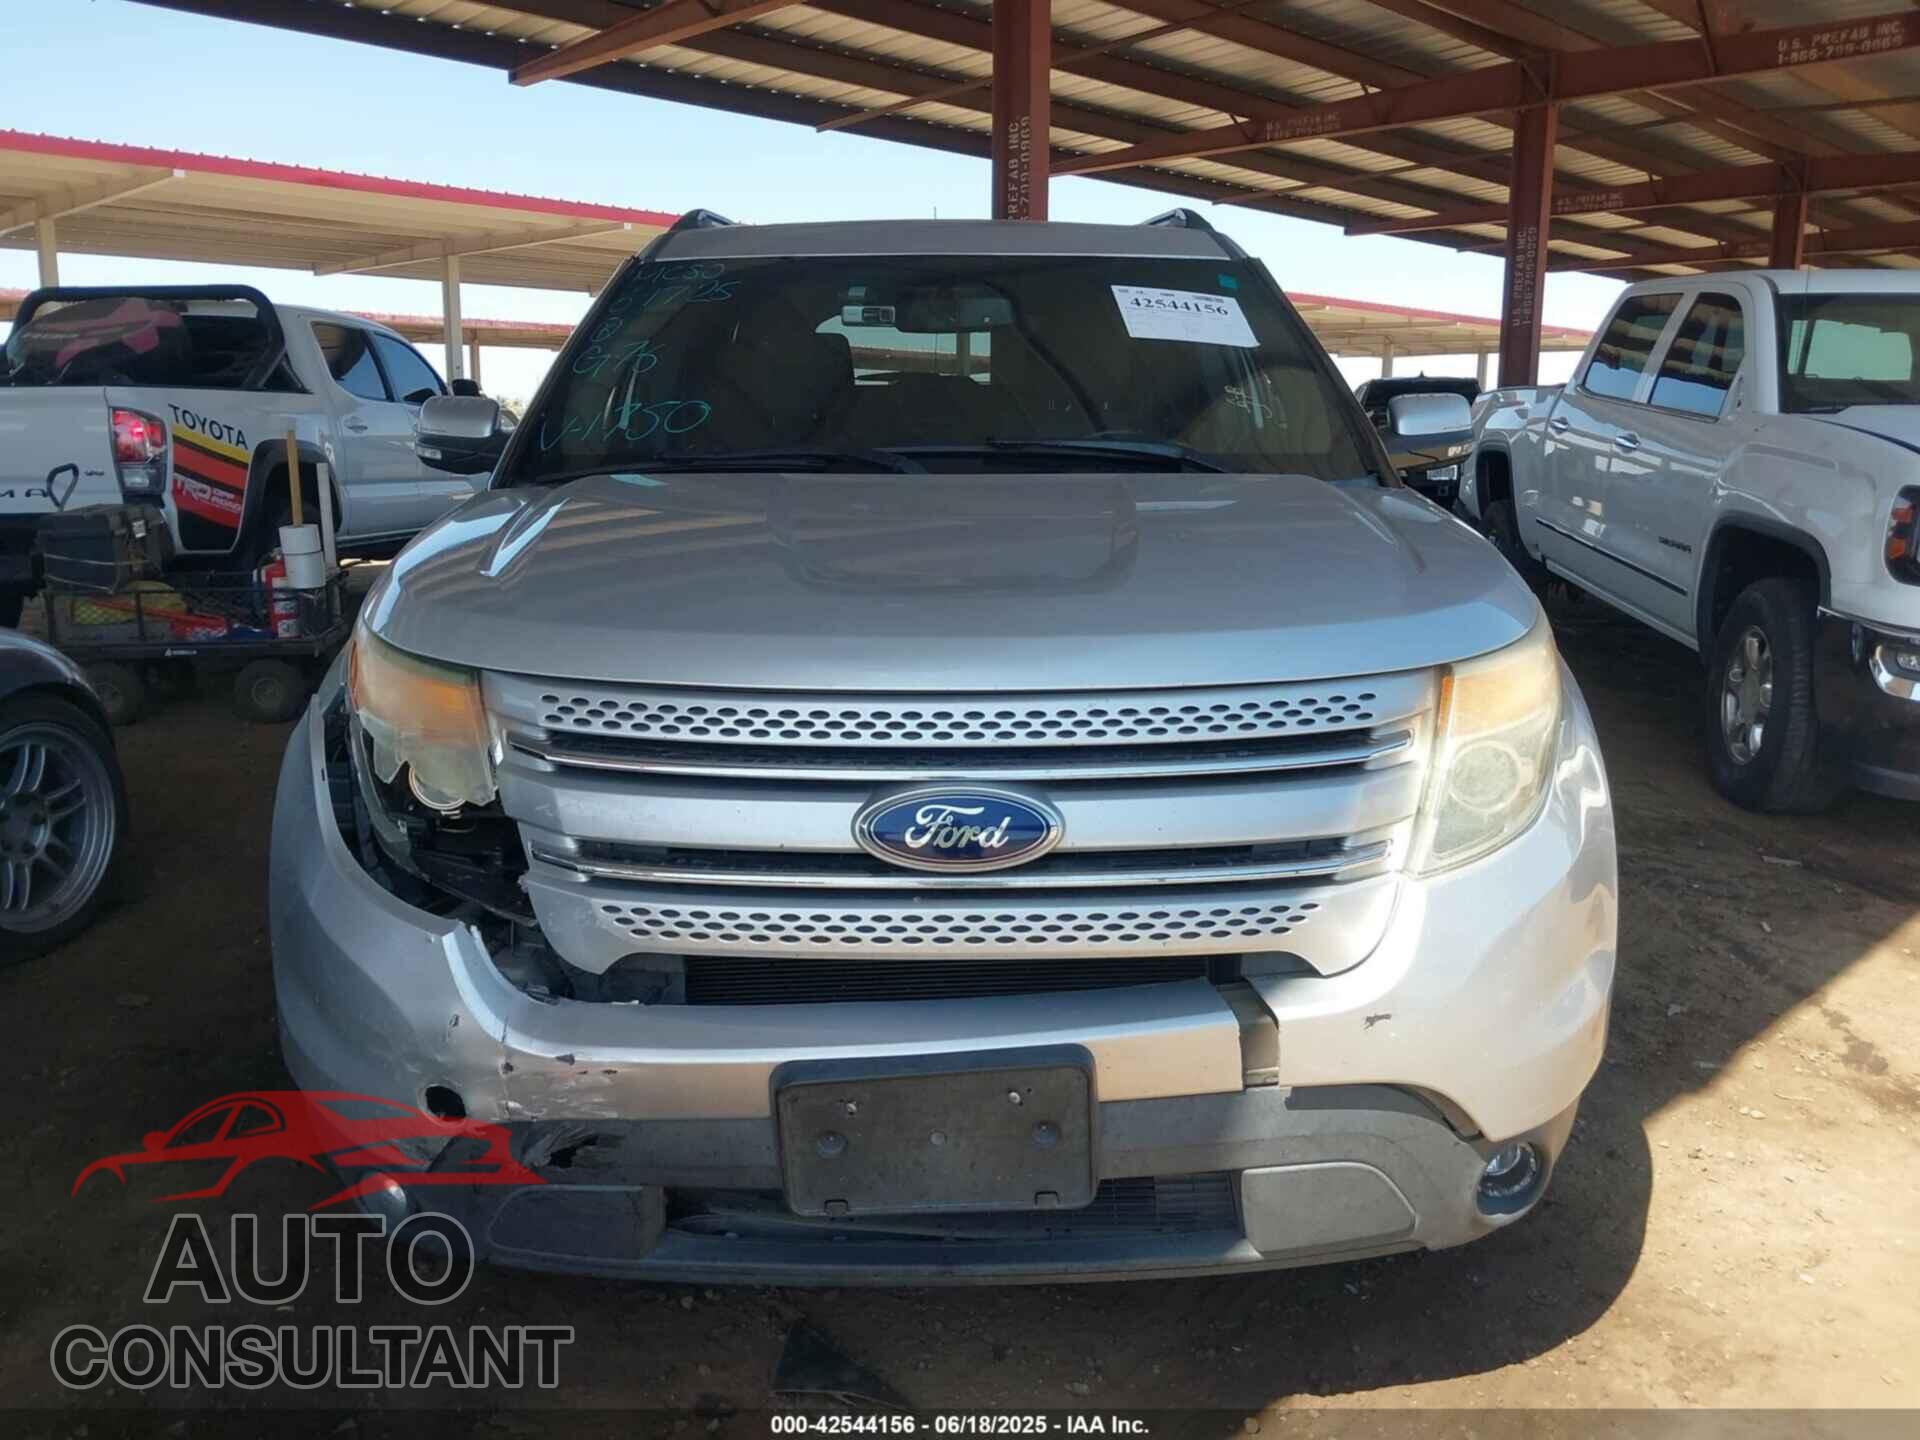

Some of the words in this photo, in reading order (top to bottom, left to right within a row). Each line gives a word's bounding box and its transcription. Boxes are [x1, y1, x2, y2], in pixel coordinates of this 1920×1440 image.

[1130, 297, 1229, 316] 42544156
[168, 403, 249, 450] TOYOTA
[905, 804, 1012, 849] Ford
